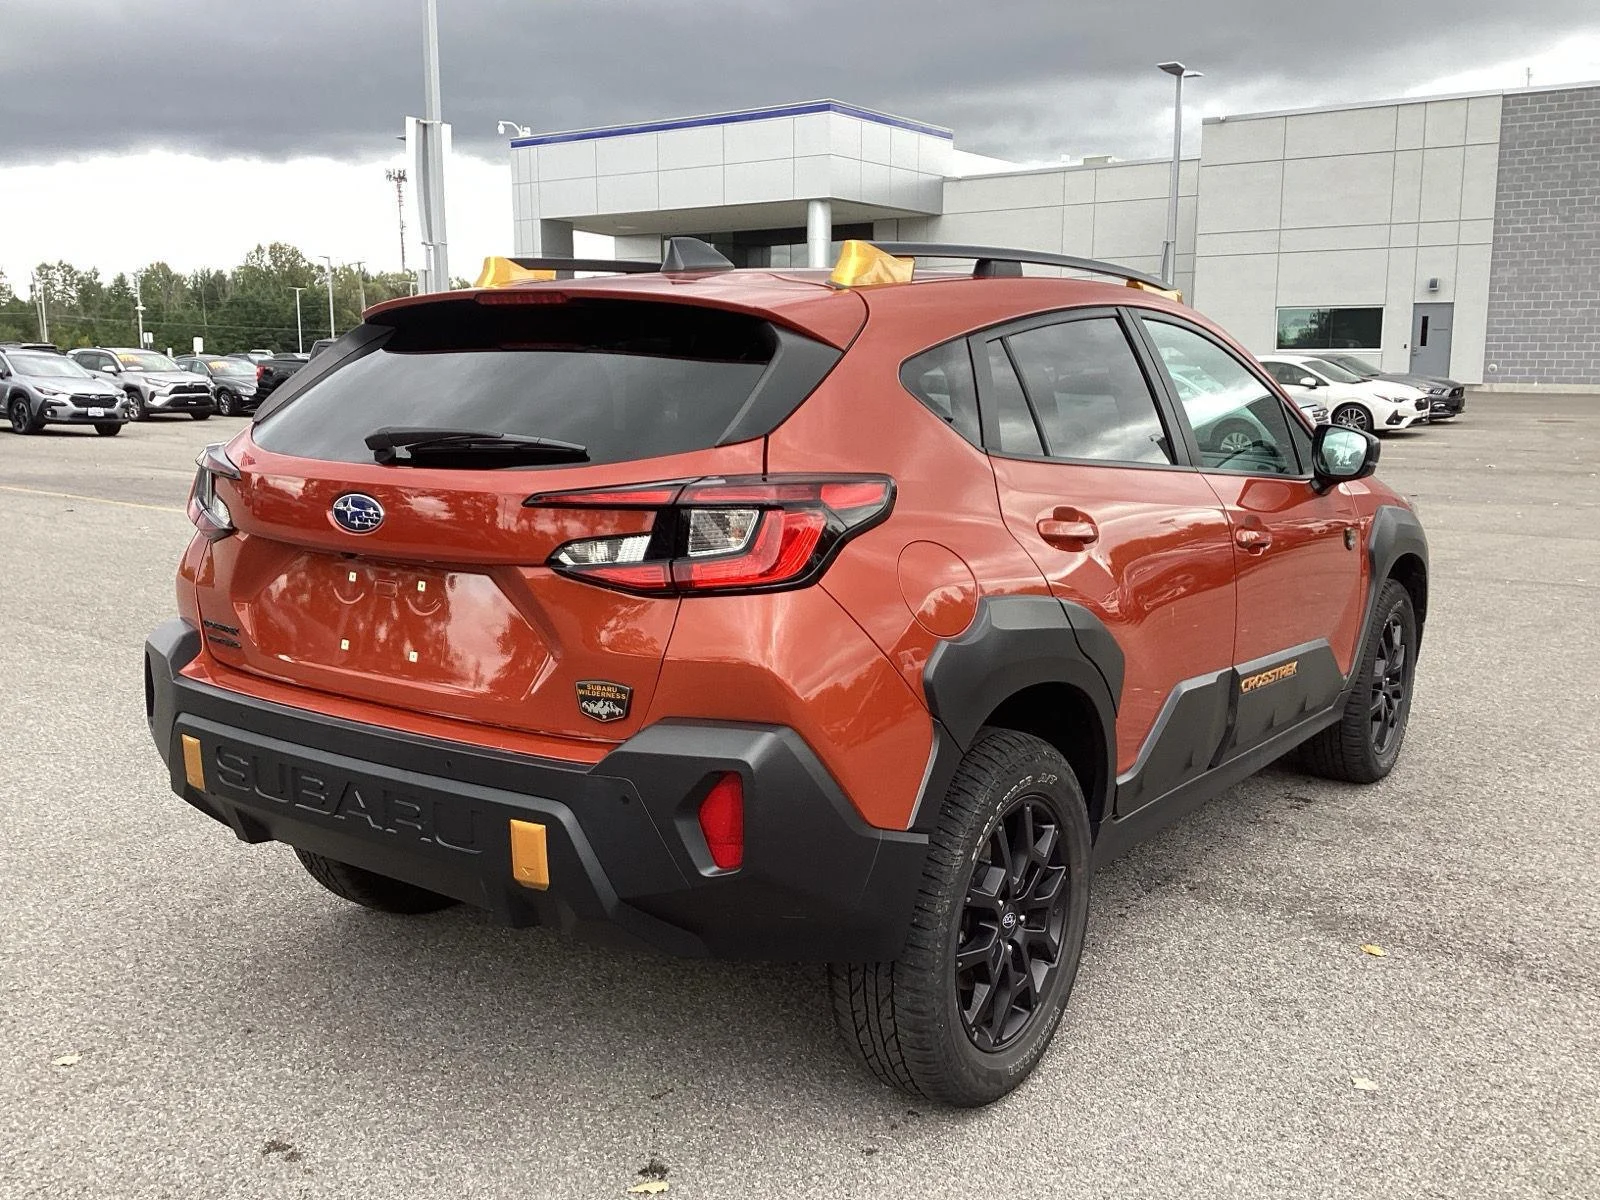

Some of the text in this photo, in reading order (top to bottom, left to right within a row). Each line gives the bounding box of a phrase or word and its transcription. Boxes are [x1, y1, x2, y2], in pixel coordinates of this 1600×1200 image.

[1241, 660, 1299, 693] CROSSTREK
[578, 688, 627, 700] WILDERNESS
[586, 683, 618, 693] SUBARU
[215, 746, 483, 854] SUBARU
